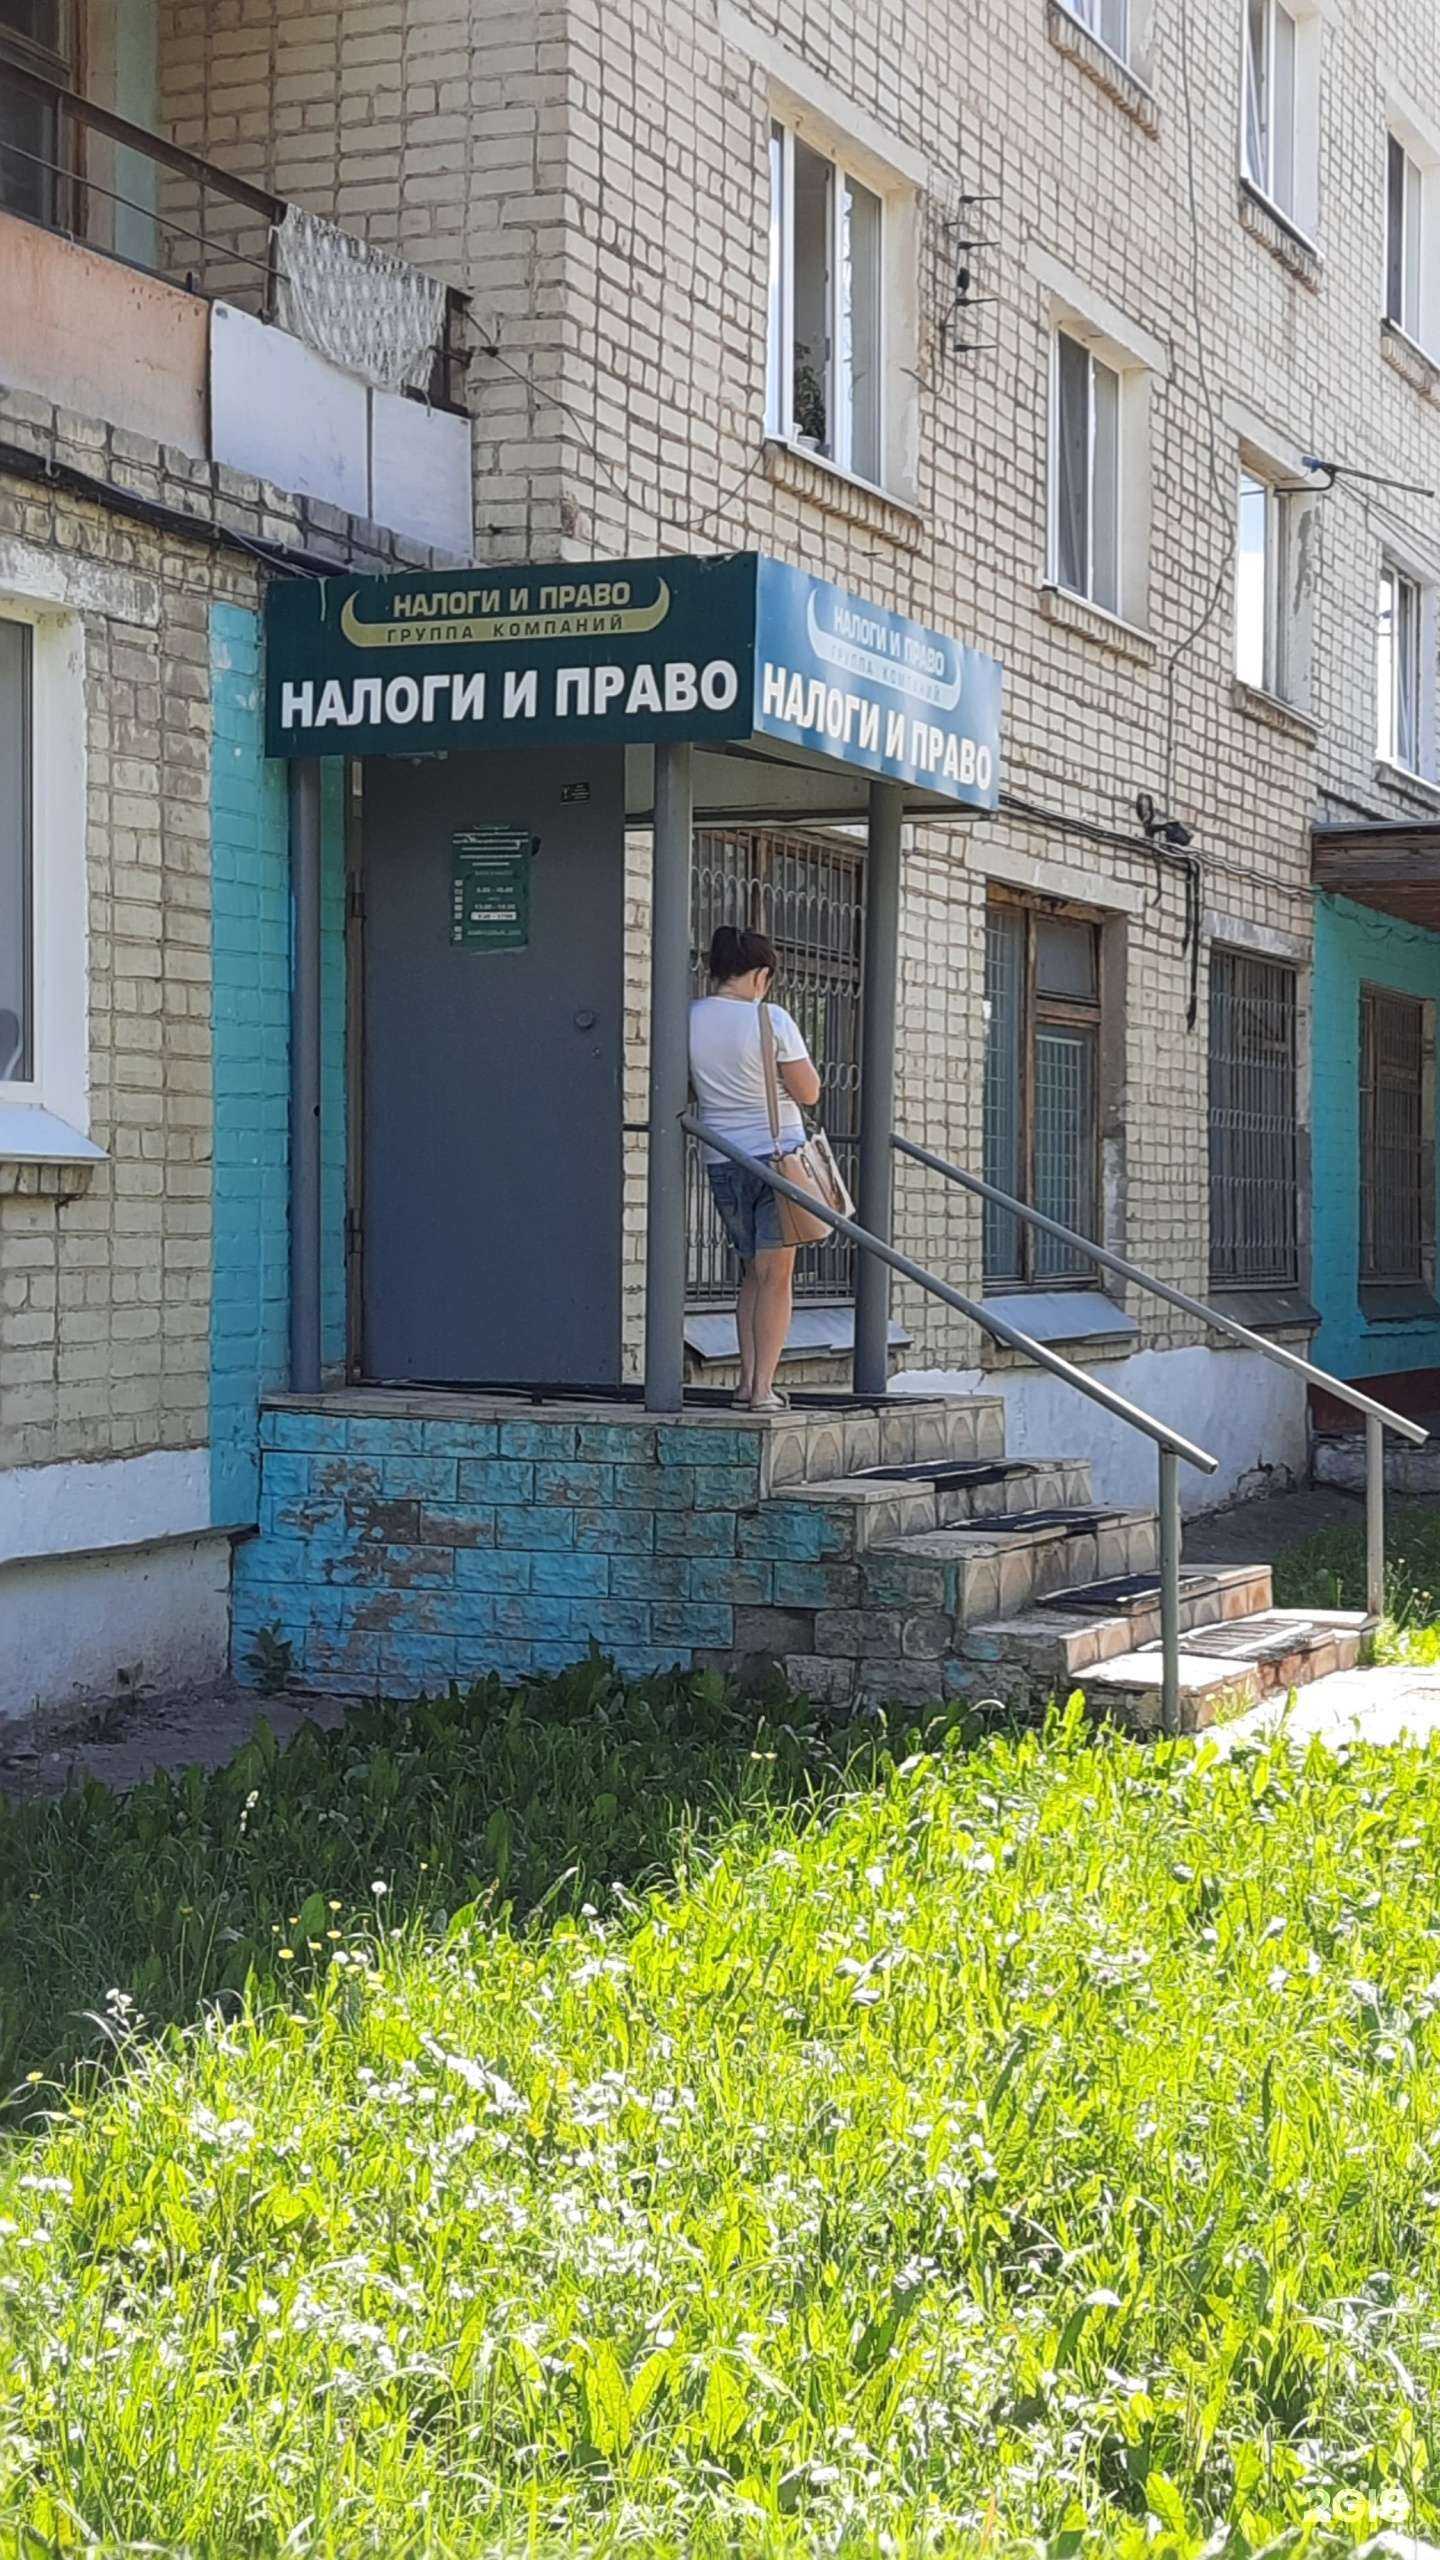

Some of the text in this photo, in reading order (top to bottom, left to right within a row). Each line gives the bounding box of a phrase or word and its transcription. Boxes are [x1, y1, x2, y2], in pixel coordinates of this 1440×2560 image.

[387, 614, 624, 644] ГРУППА КОМПАНИЙ
[393, 582, 631, 618] НАЛОГИ И ПРАВО
[832, 605, 945, 677] НАЛОГИ И ПРАВО
[281, 660, 739, 729] НАЛОГИ И ПРАВО
[762, 662, 992, 791] НАЛОГИ И ПРАВО
